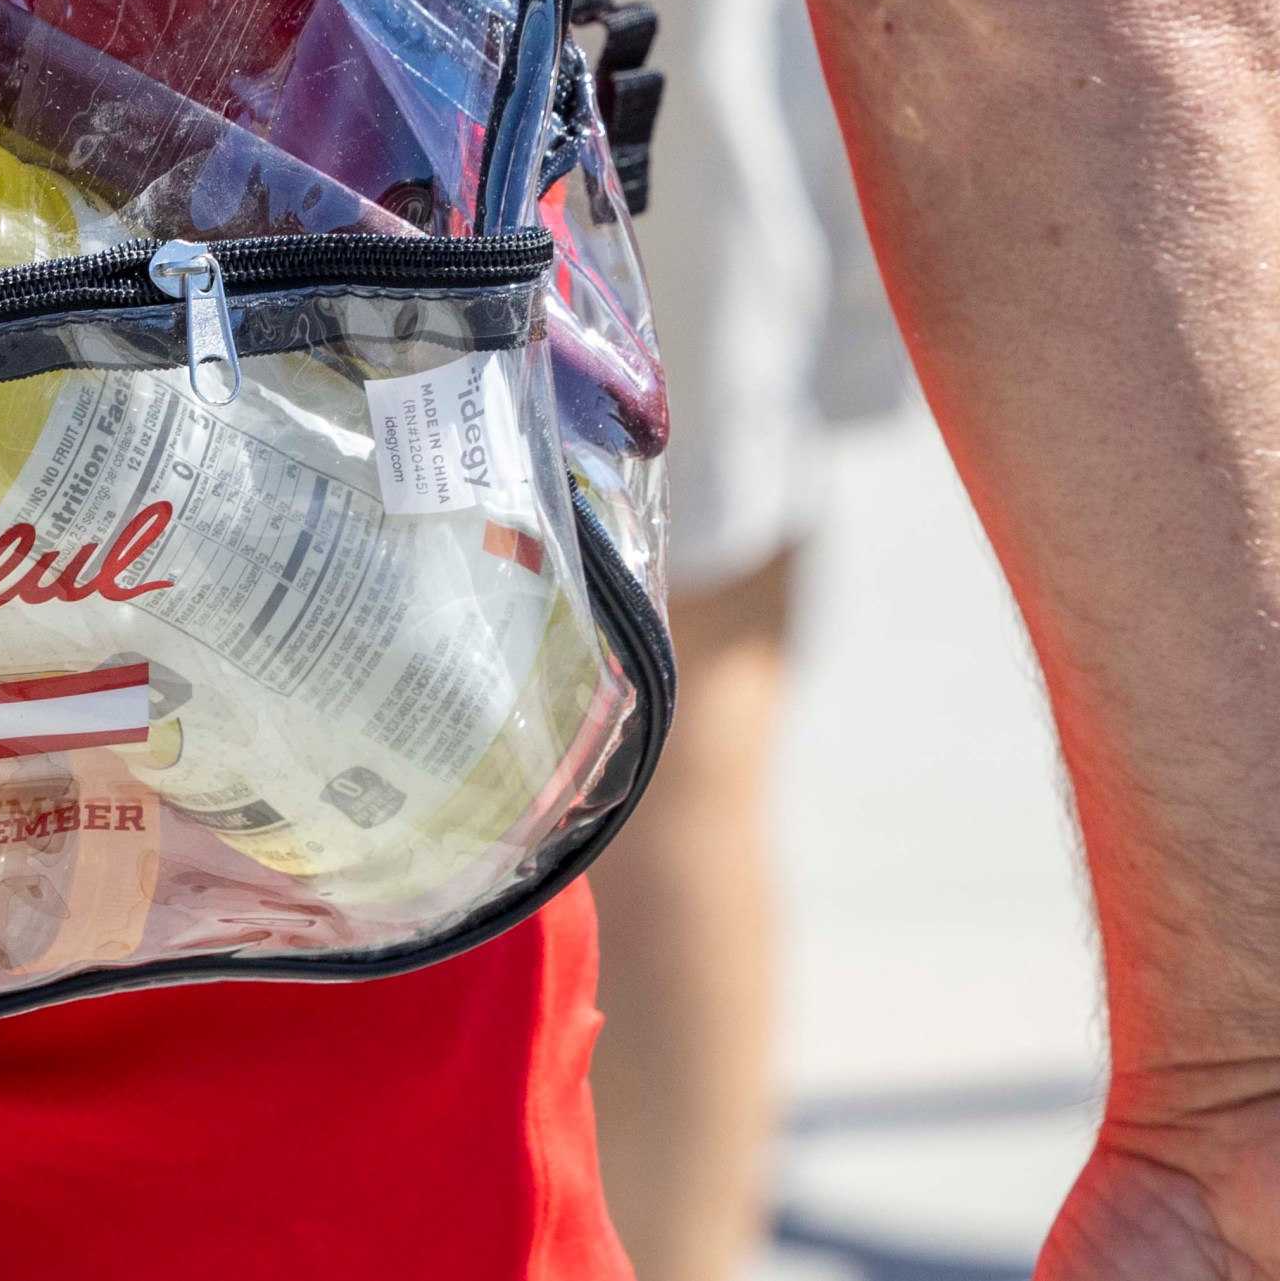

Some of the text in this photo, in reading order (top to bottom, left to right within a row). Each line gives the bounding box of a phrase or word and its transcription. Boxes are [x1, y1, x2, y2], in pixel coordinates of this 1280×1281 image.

[12, 486, 48, 525] TAINS
[40, 465, 60, 488] NO
[53, 425, 80, 466] FRUIT
[82, 484, 111, 526] servings
[104, 466, 119, 486] per
[113, 421, 138, 468] container
[97, 510, 116, 534] size
[127, 456, 143, 472] 12
[140, 431, 153, 447] oz
[172, 460, 194, 481] 0
[188, 409, 210, 430] 5
[384, 416, 404, 483] idegy.com
[402, 399, 430, 496] (RN#120445)
[421, 383, 451, 505] MADE IN CHINA
[458, 388, 491, 488] idegy
[32, 443, 109, 557] Nutrition
